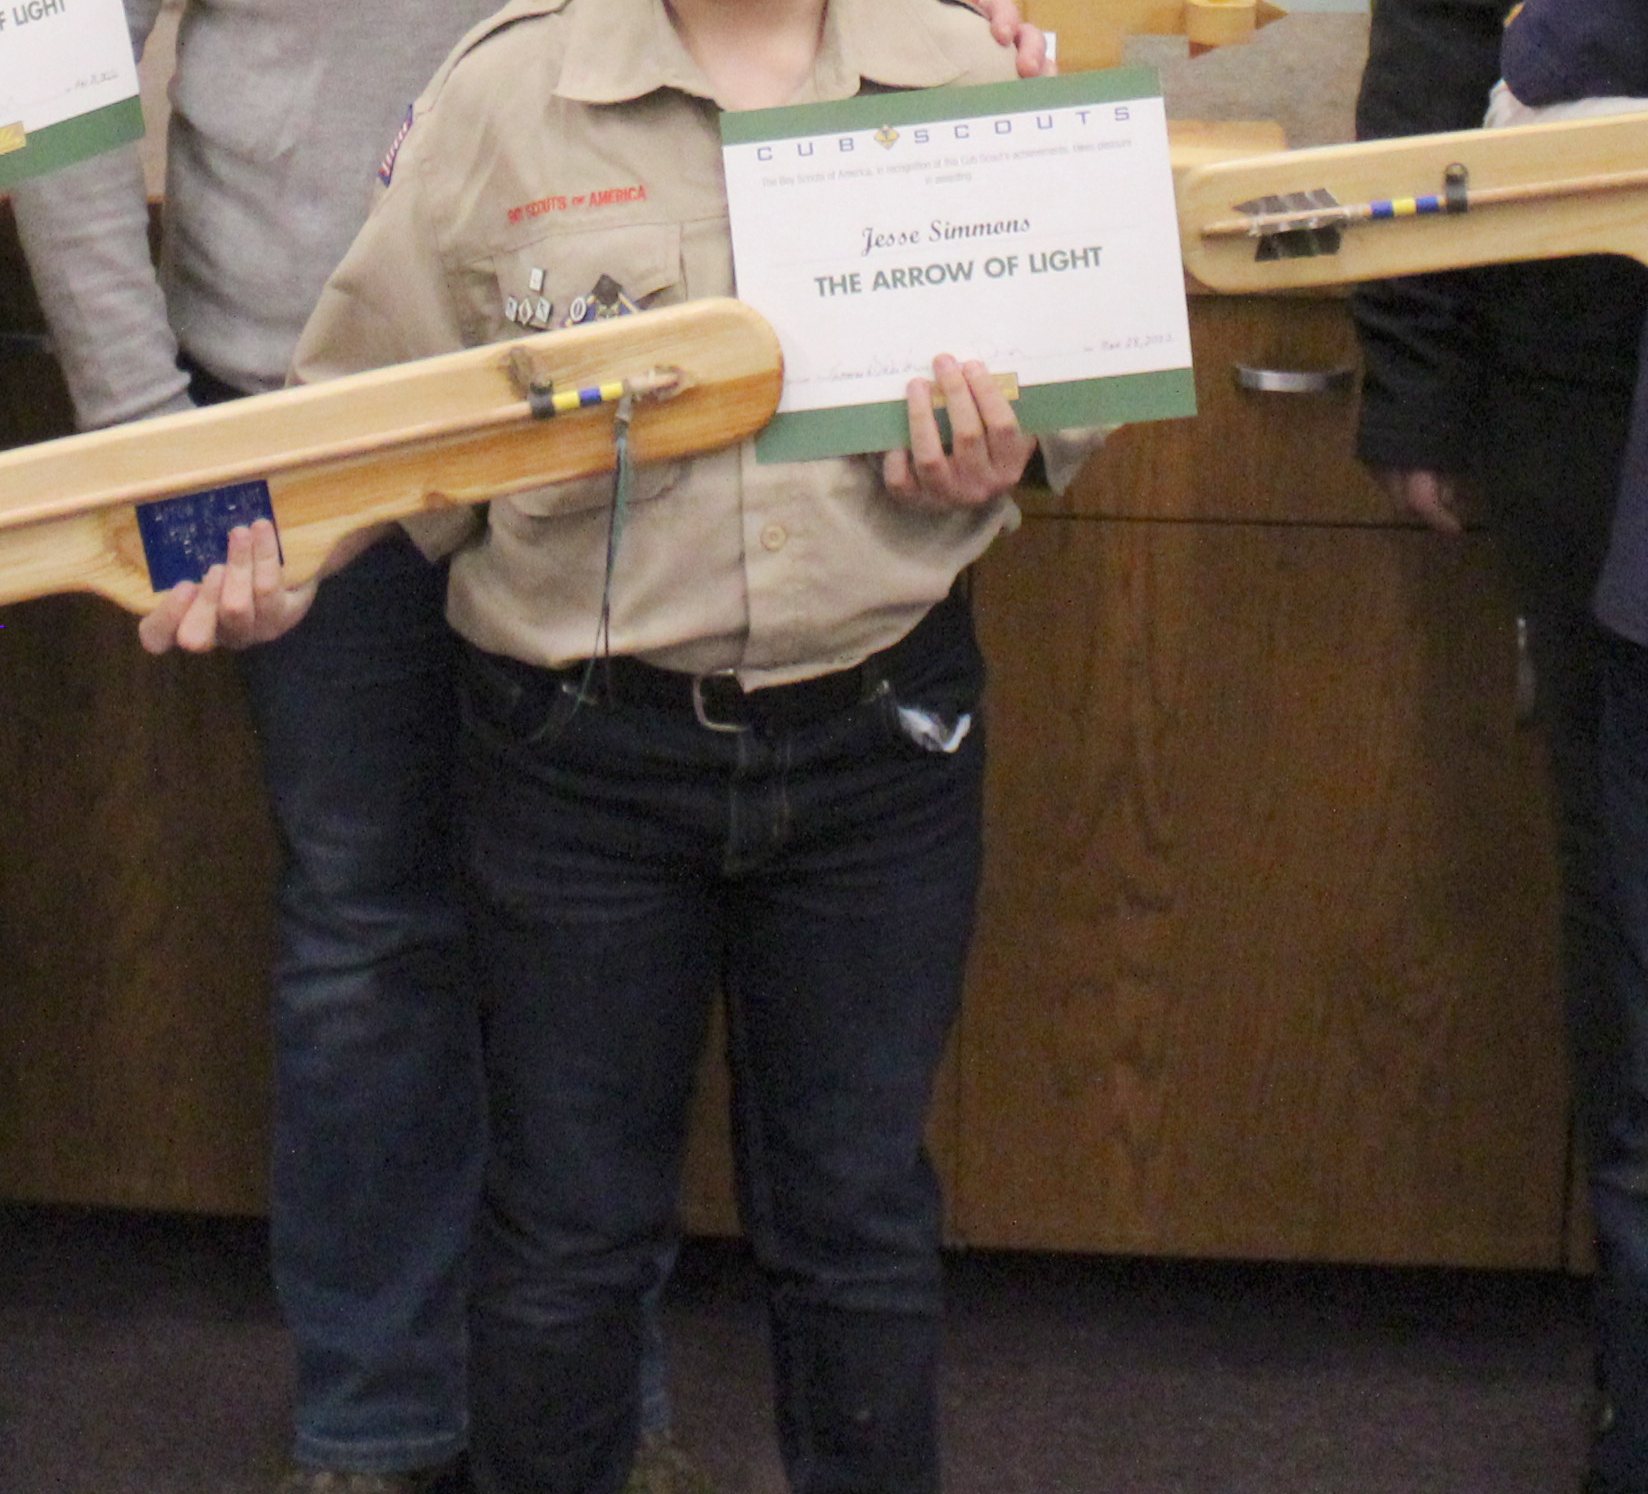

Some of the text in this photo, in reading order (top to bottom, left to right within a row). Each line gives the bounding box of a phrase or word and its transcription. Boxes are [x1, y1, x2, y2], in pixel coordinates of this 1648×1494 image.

[757, 107, 1130, 161] CUB SCOUTS
[589, 185, 647, 207] AMERICA
[860, 217, 1031, 256] Jesse Simmons
[814, 246, 1103, 298] THE ARROW OF LIGHT
